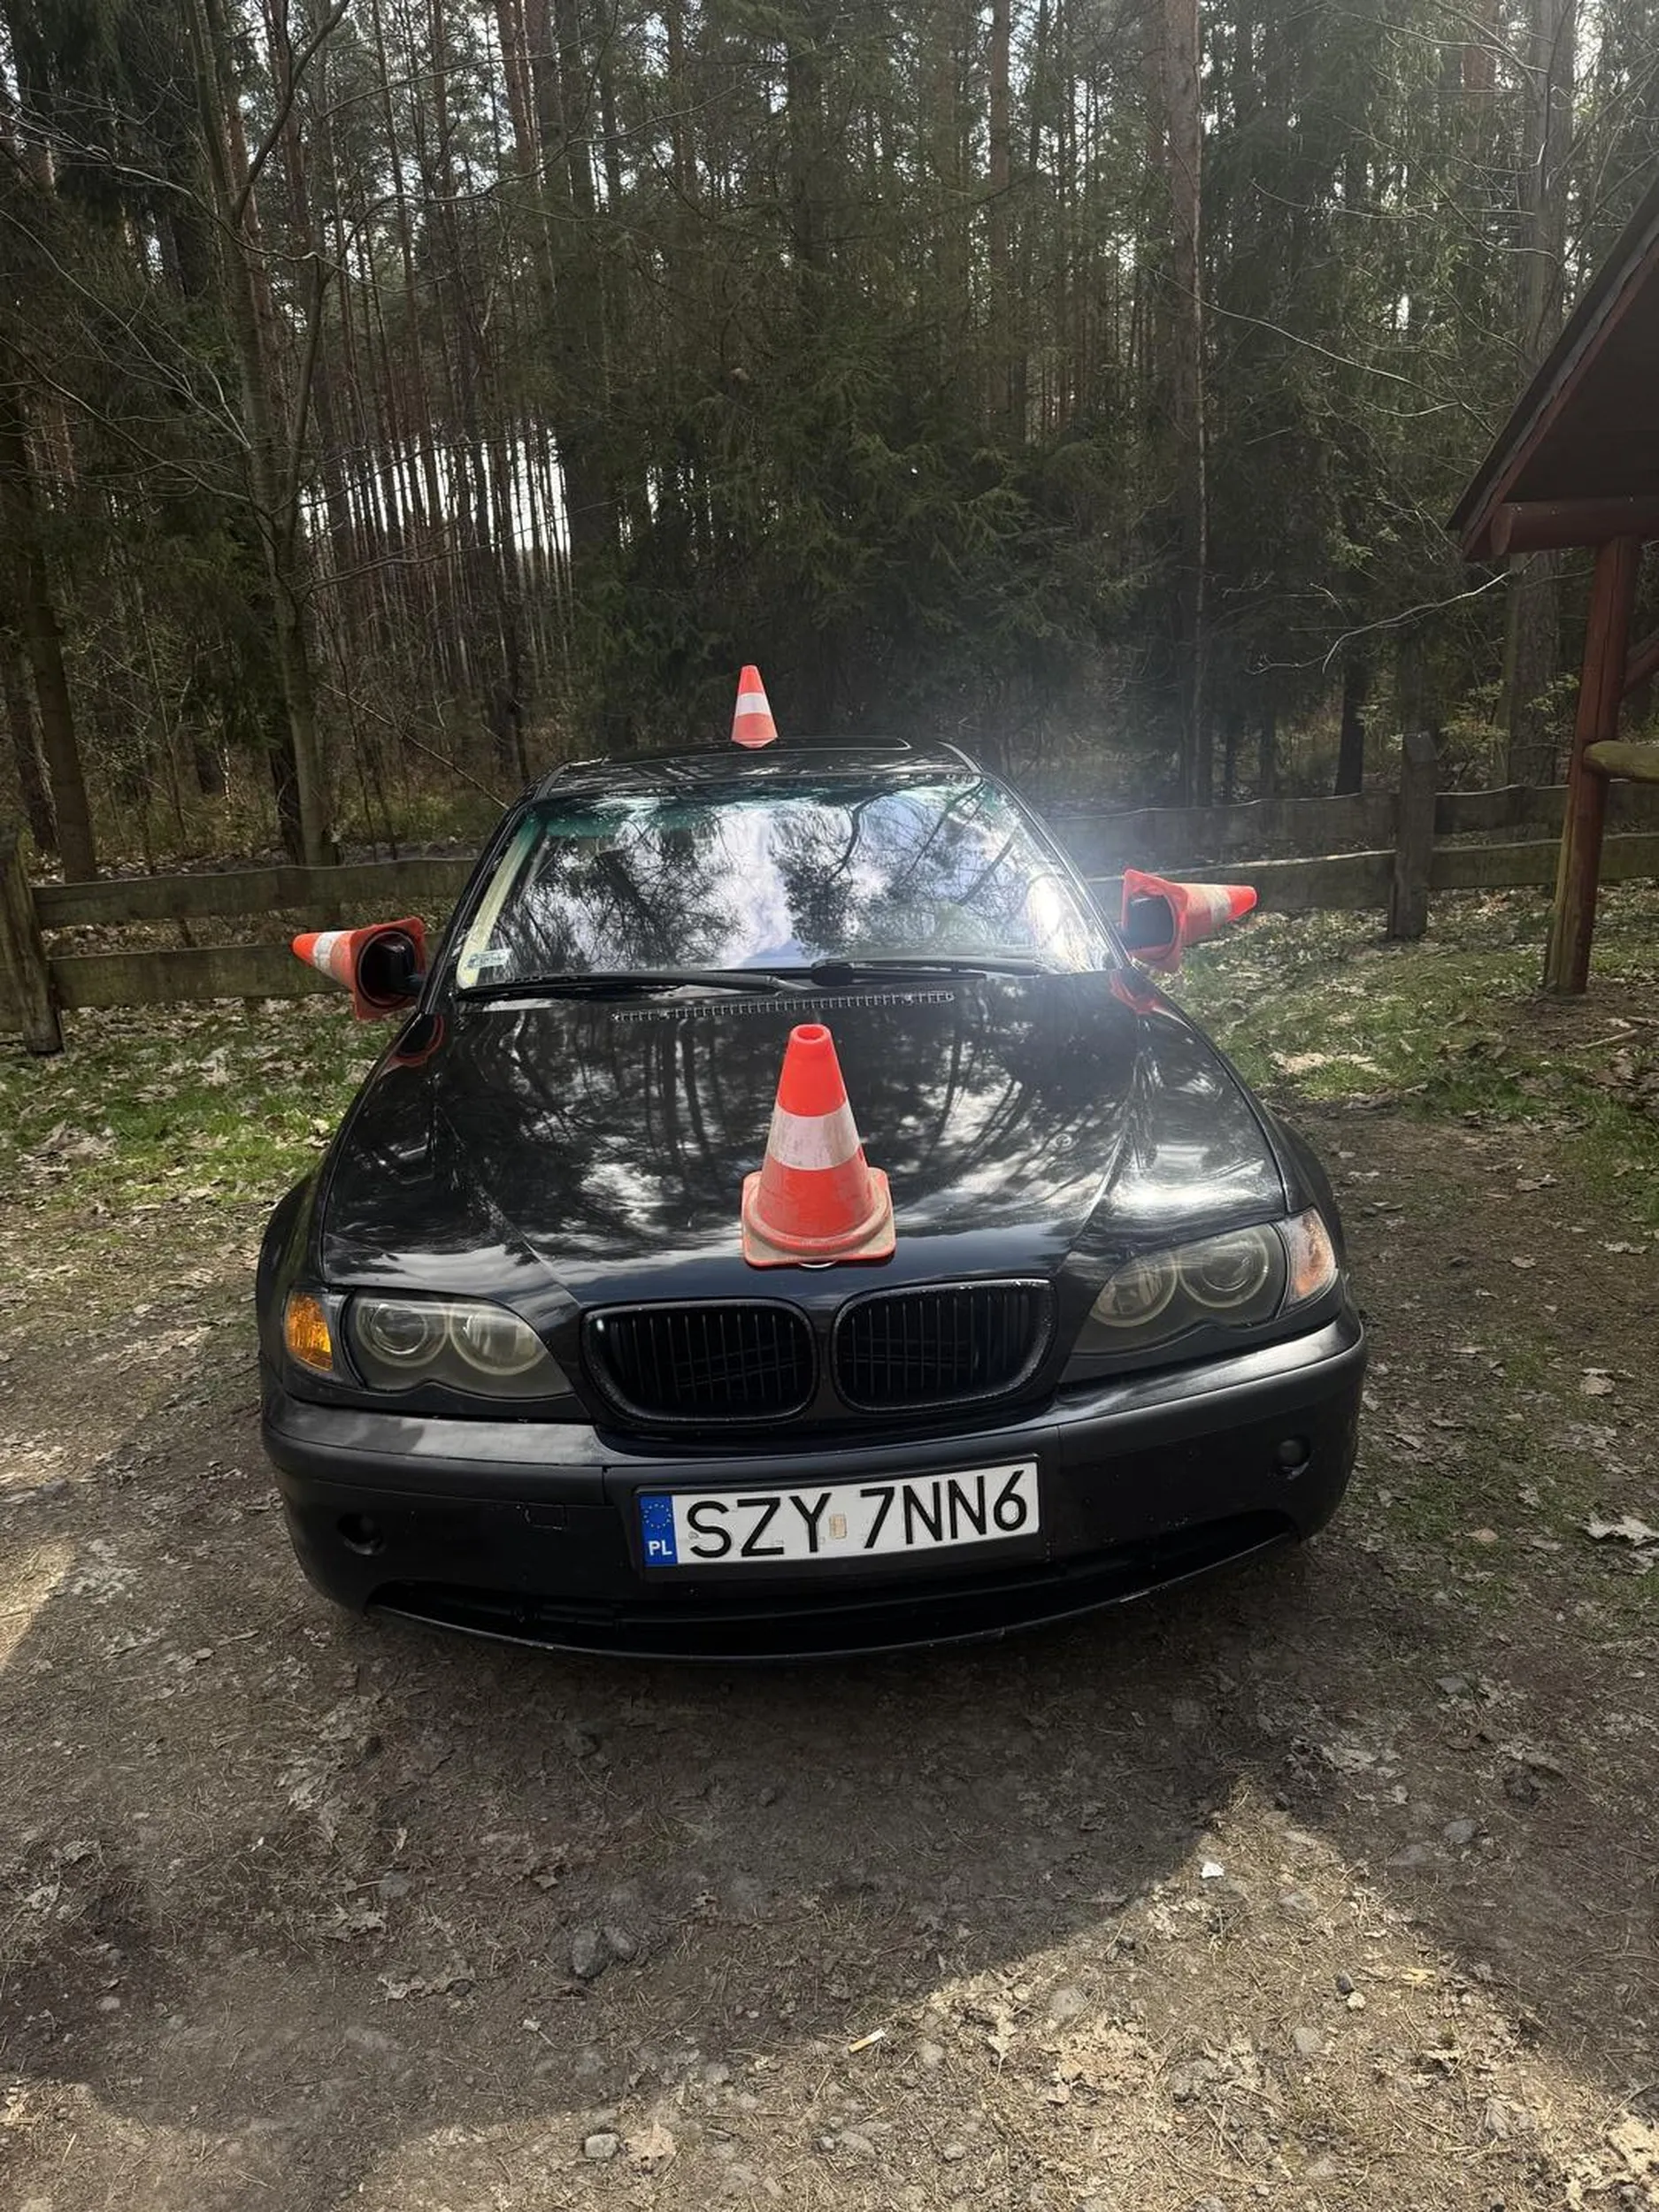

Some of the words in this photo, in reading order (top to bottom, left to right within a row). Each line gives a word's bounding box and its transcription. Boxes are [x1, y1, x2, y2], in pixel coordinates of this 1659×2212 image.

[687, 1493, 832, 1558] SZY
[860, 1470, 1027, 1549] 7NN6
[648, 1540, 673, 1556] PL
